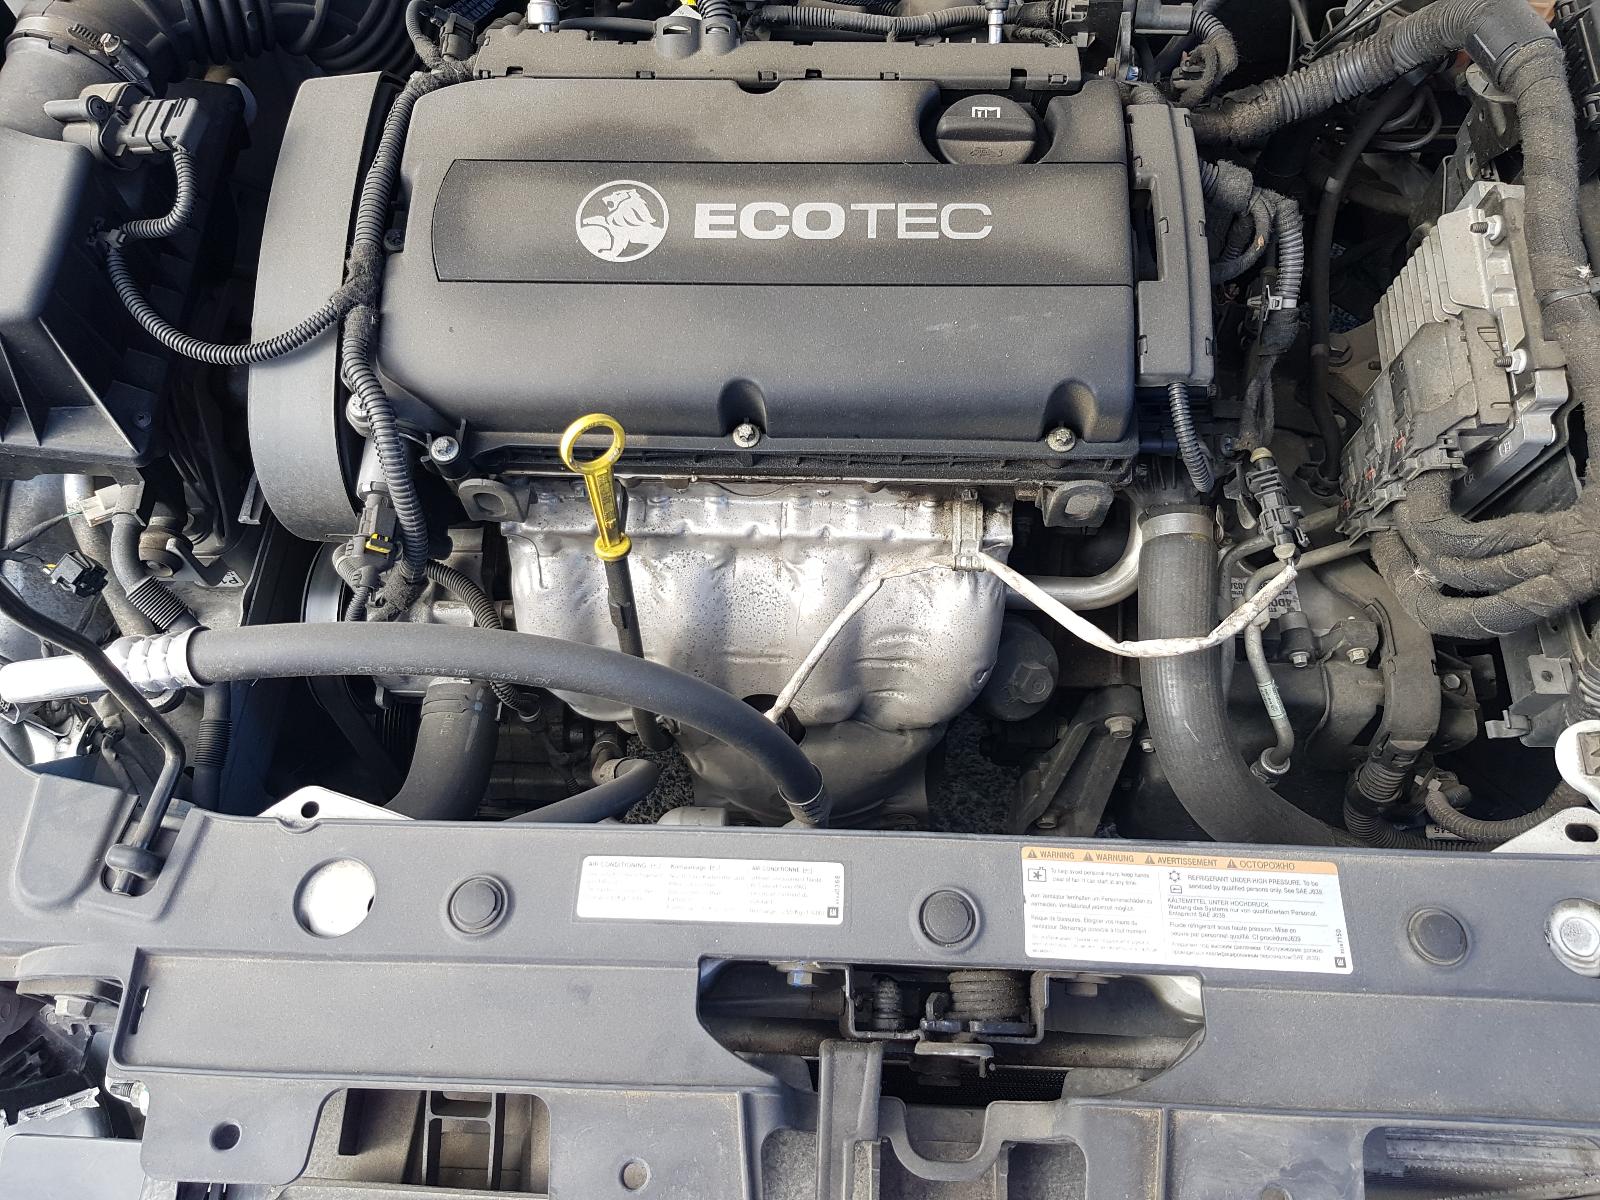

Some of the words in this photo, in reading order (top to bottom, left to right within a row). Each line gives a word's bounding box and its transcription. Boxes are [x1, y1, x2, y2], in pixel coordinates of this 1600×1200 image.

[693, 201, 993, 241] ECOTEC
[1040, 851, 1074, 859] WARNING
[1096, 853, 1134, 863] WARNUNG
[1157, 856, 1217, 867] AVERTISSEMENT
[1239, 861, 1295, 870] ОСТОРОЖНО
[1188, 874, 1229, 882] REFRIGERANT
